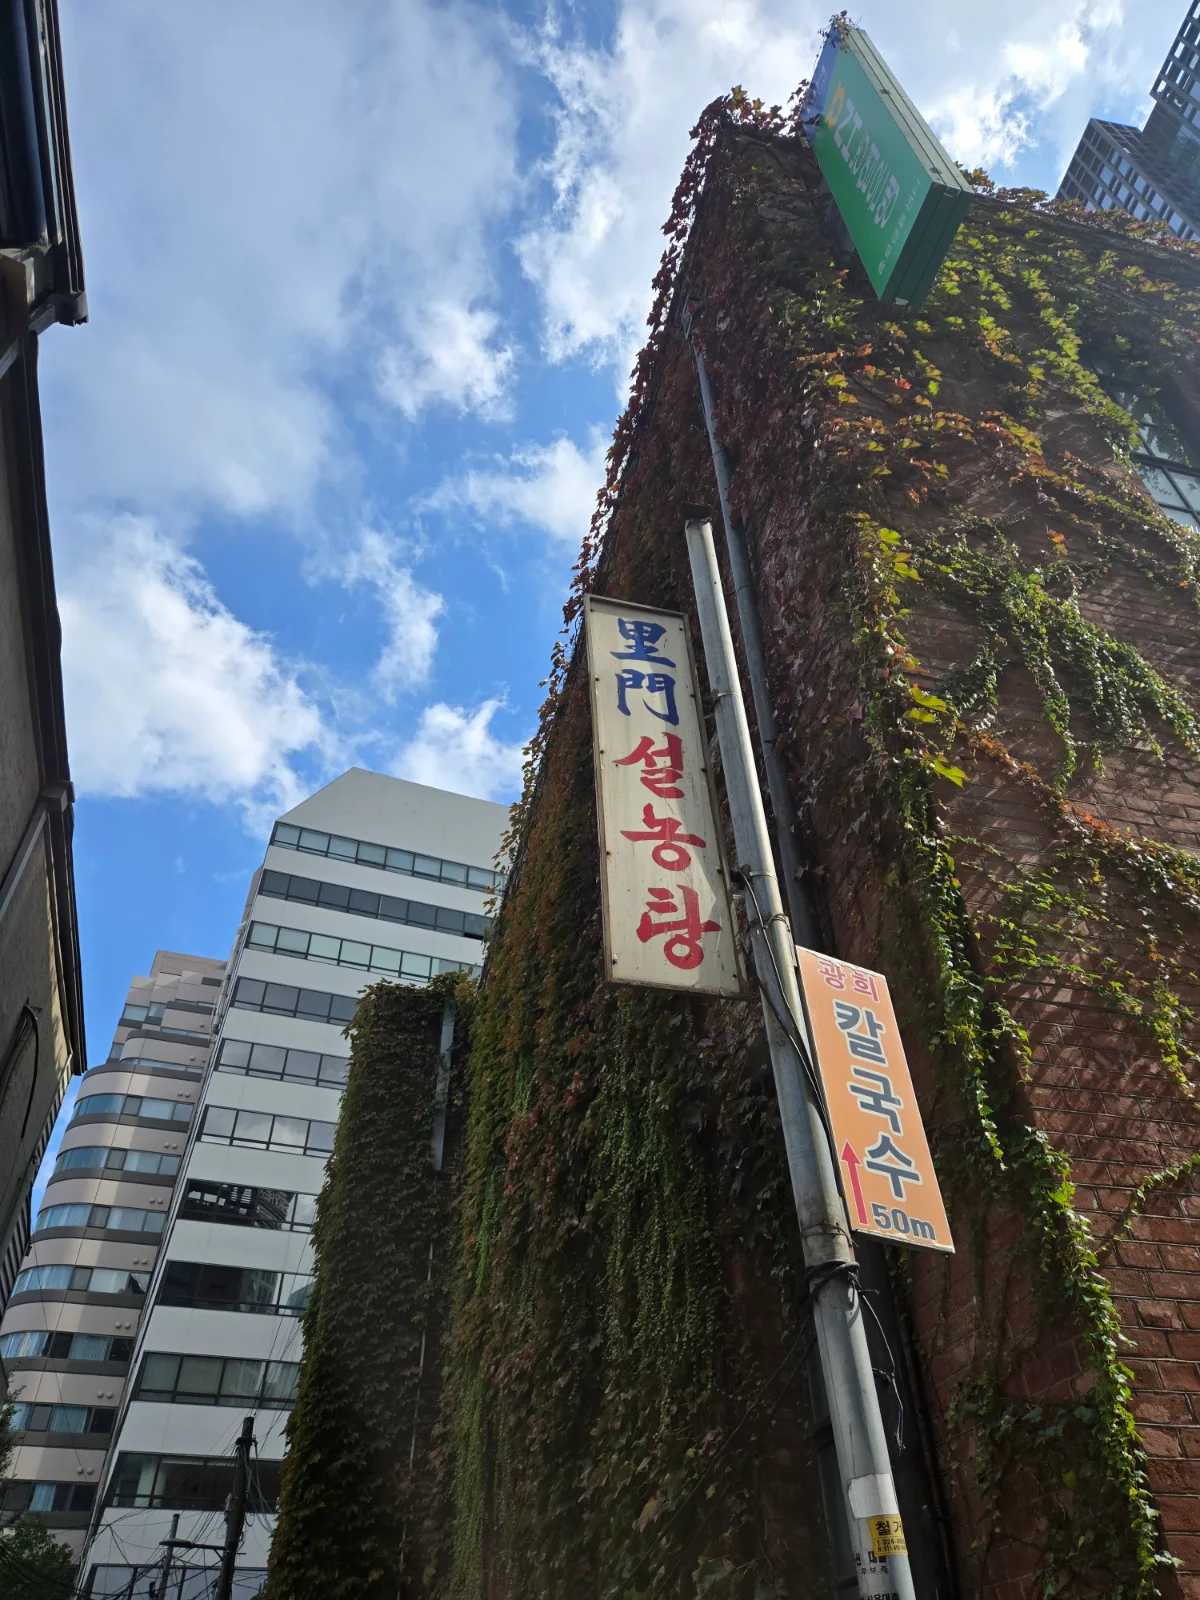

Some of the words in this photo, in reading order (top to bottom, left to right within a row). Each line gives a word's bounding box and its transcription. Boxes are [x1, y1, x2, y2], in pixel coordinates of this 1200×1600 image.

[609, 616, 680, 726] 里門
[612, 730, 723, 971] 설농탕
[818, 958, 880, 1004] 광희
[833, 1000, 921, 1201] 칼국수
[871, 1203, 937, 1241] 50m
